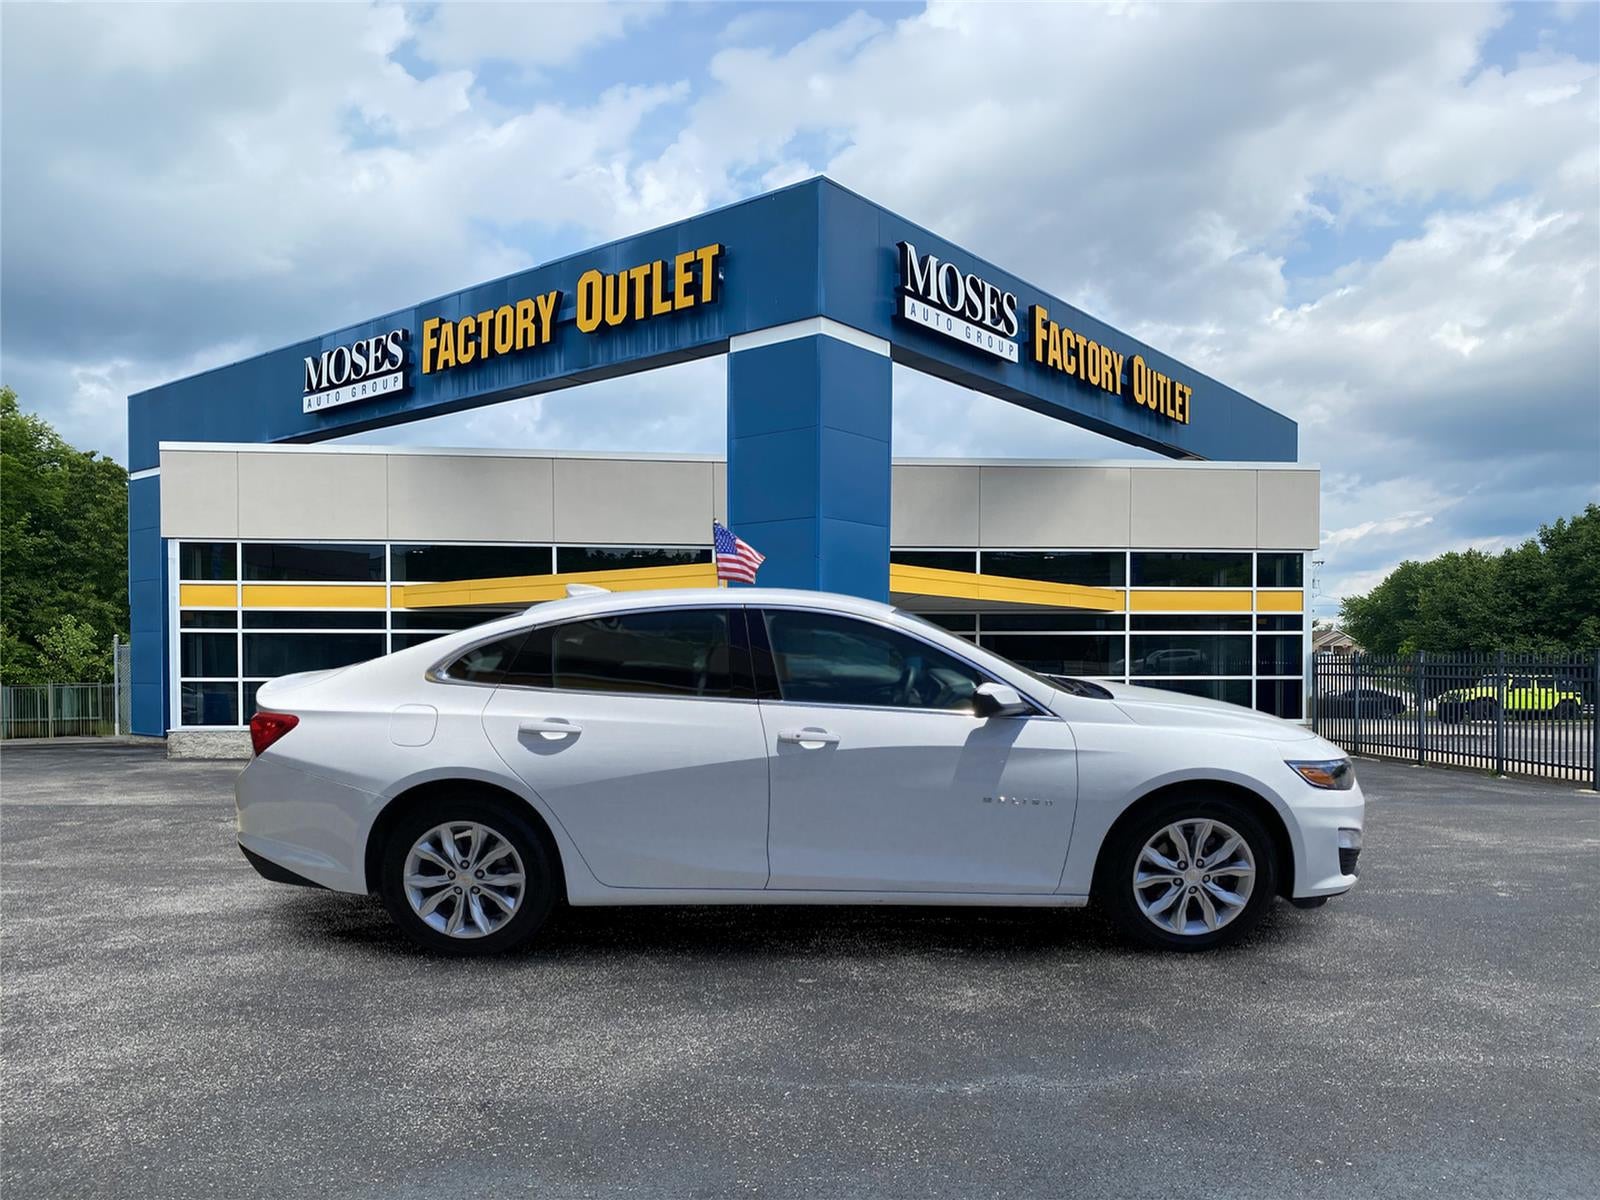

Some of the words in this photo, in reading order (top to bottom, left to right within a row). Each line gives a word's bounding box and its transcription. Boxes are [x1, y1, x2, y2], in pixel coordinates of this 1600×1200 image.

[422, 290, 559, 374] FACTORY
[576, 243, 720, 333] OUTLET
[903, 241, 1019, 337] MOSES
[910, 301, 953, 332] AUTO
[965, 325, 1014, 356] GROUP
[303, 329, 405, 392] MOSES
[307, 389, 341, 410] AUTO
[351, 375, 400, 402] GROUP
[1035, 304, 1124, 395] FACTORY
[1133, 354, 1192, 425] OUTLET
